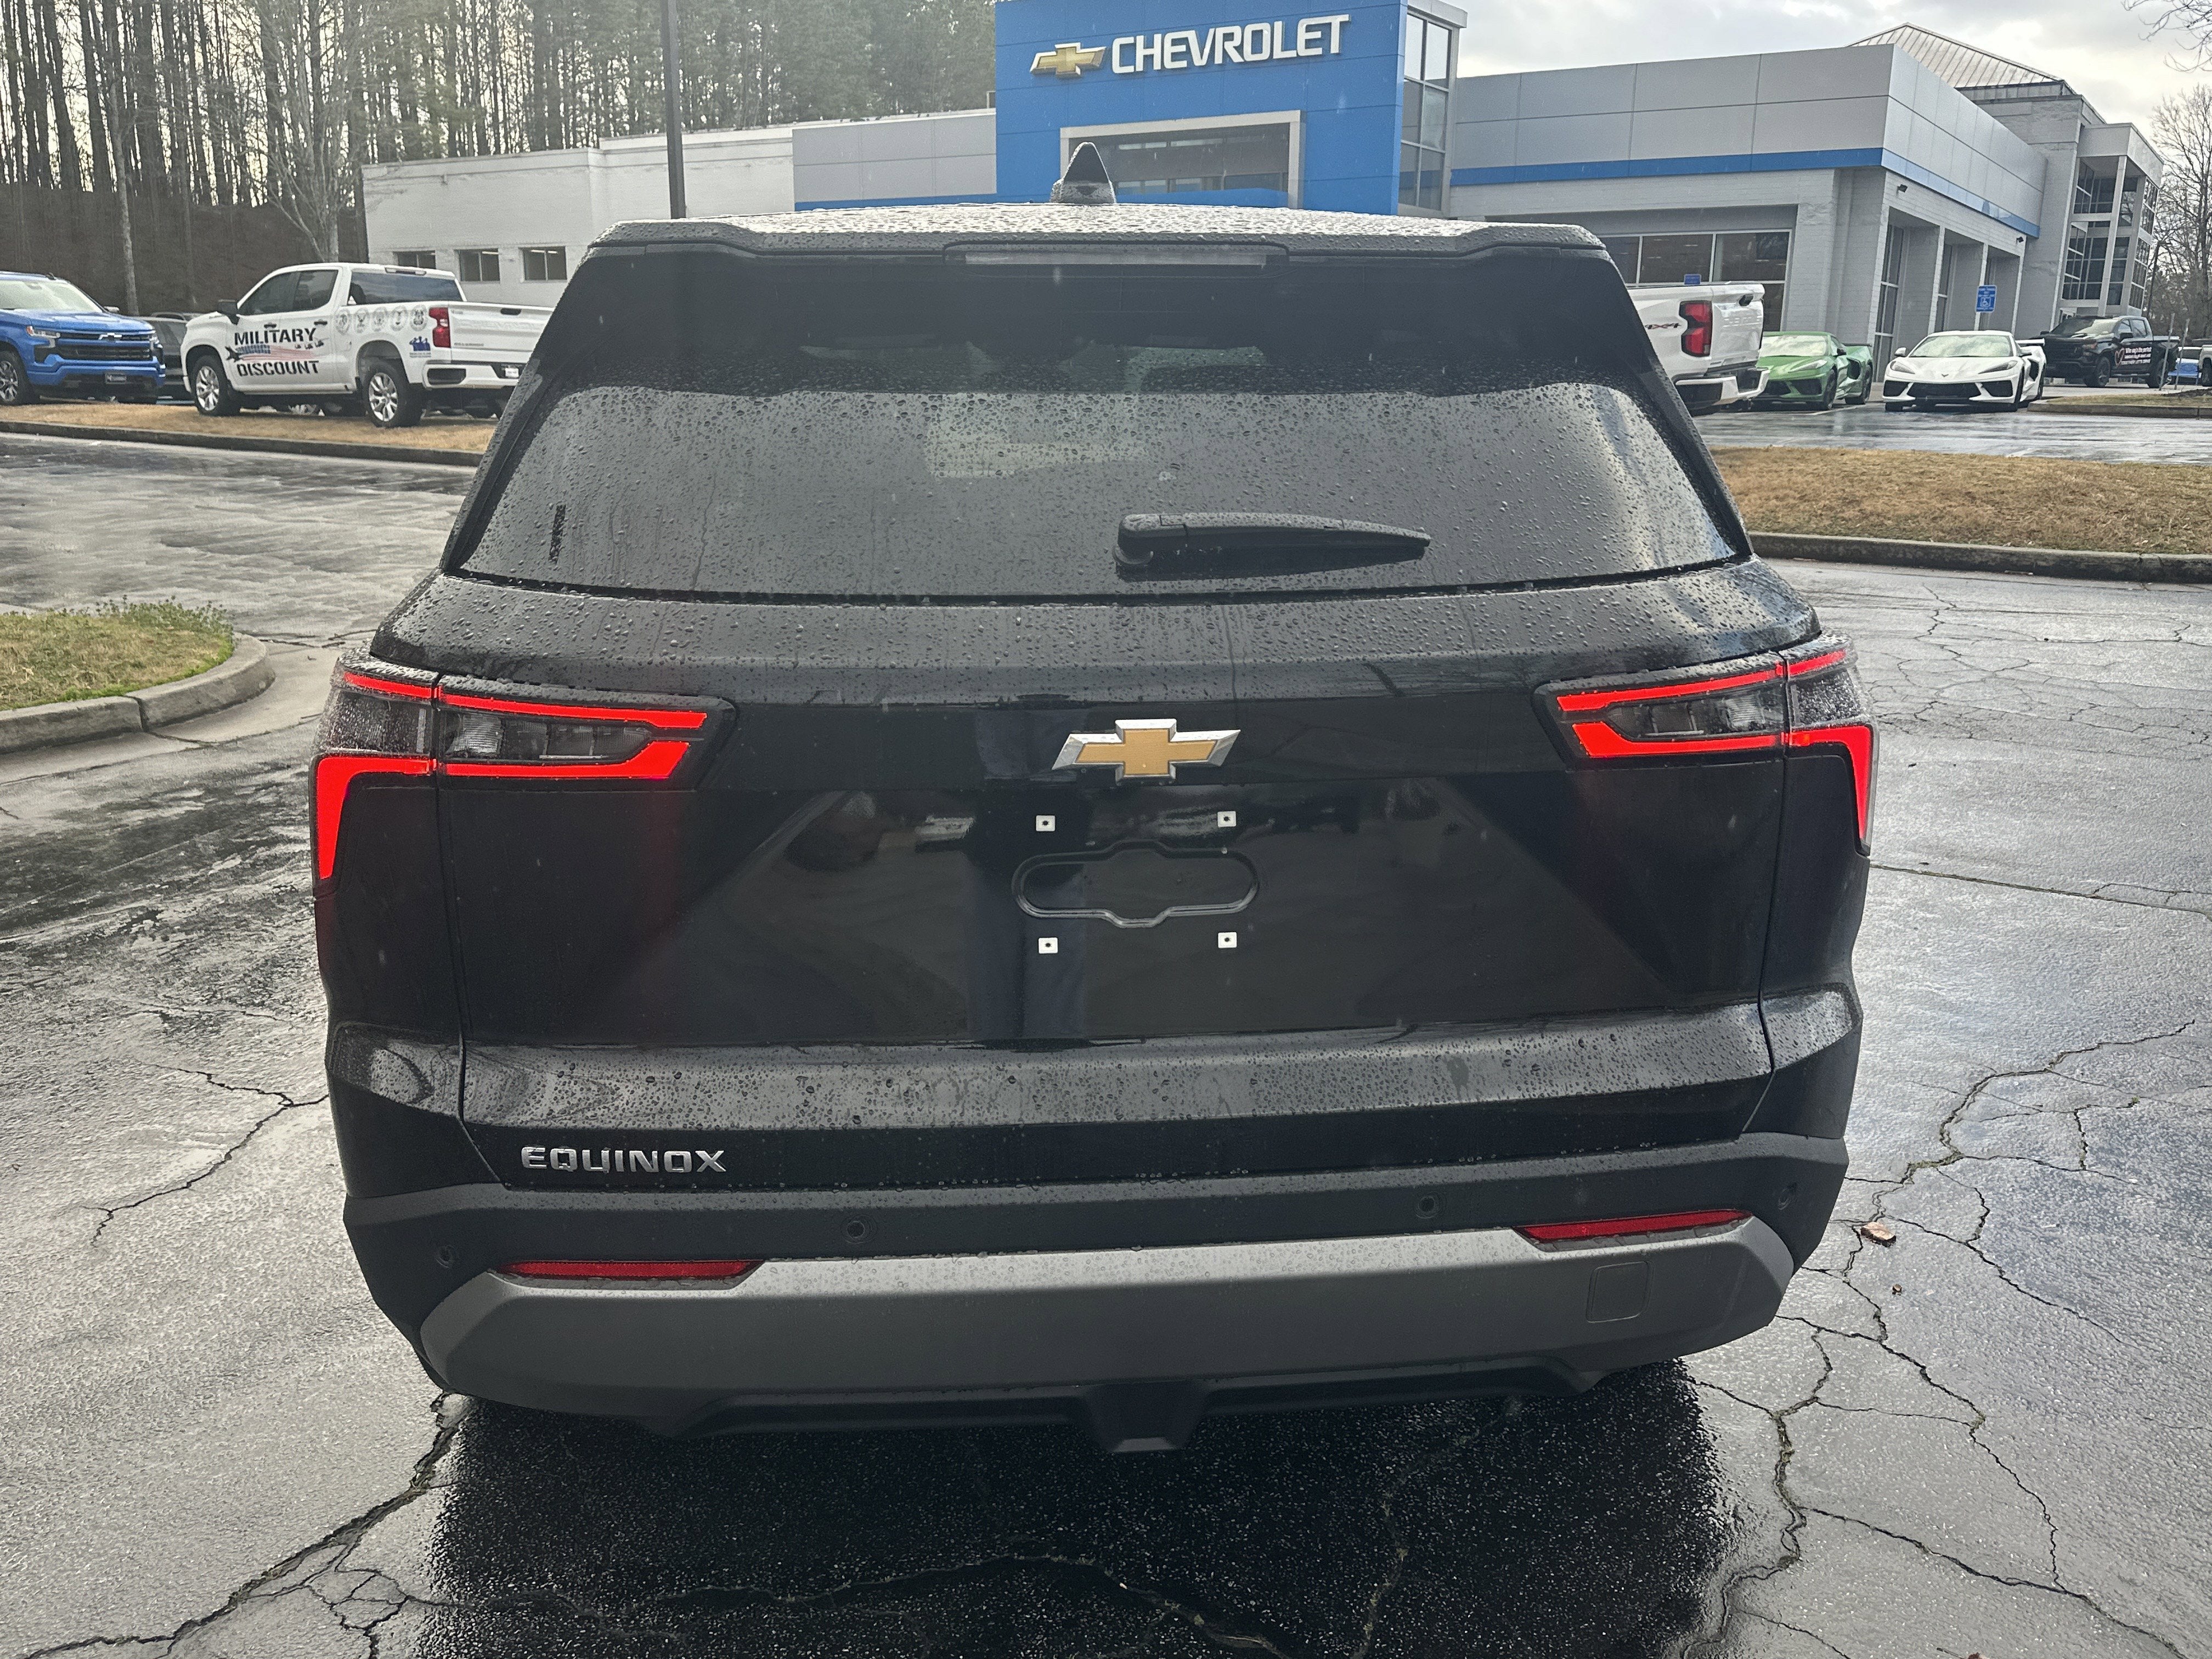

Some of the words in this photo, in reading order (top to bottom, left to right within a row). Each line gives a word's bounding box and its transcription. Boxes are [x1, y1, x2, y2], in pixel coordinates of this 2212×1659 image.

[1113, 14, 1350, 74] CHEVROLET
[235, 328, 317, 345] MILITARY
[237, 360, 319, 376] DISCOUNT
[521, 1146, 726, 1173] EQUINOX
